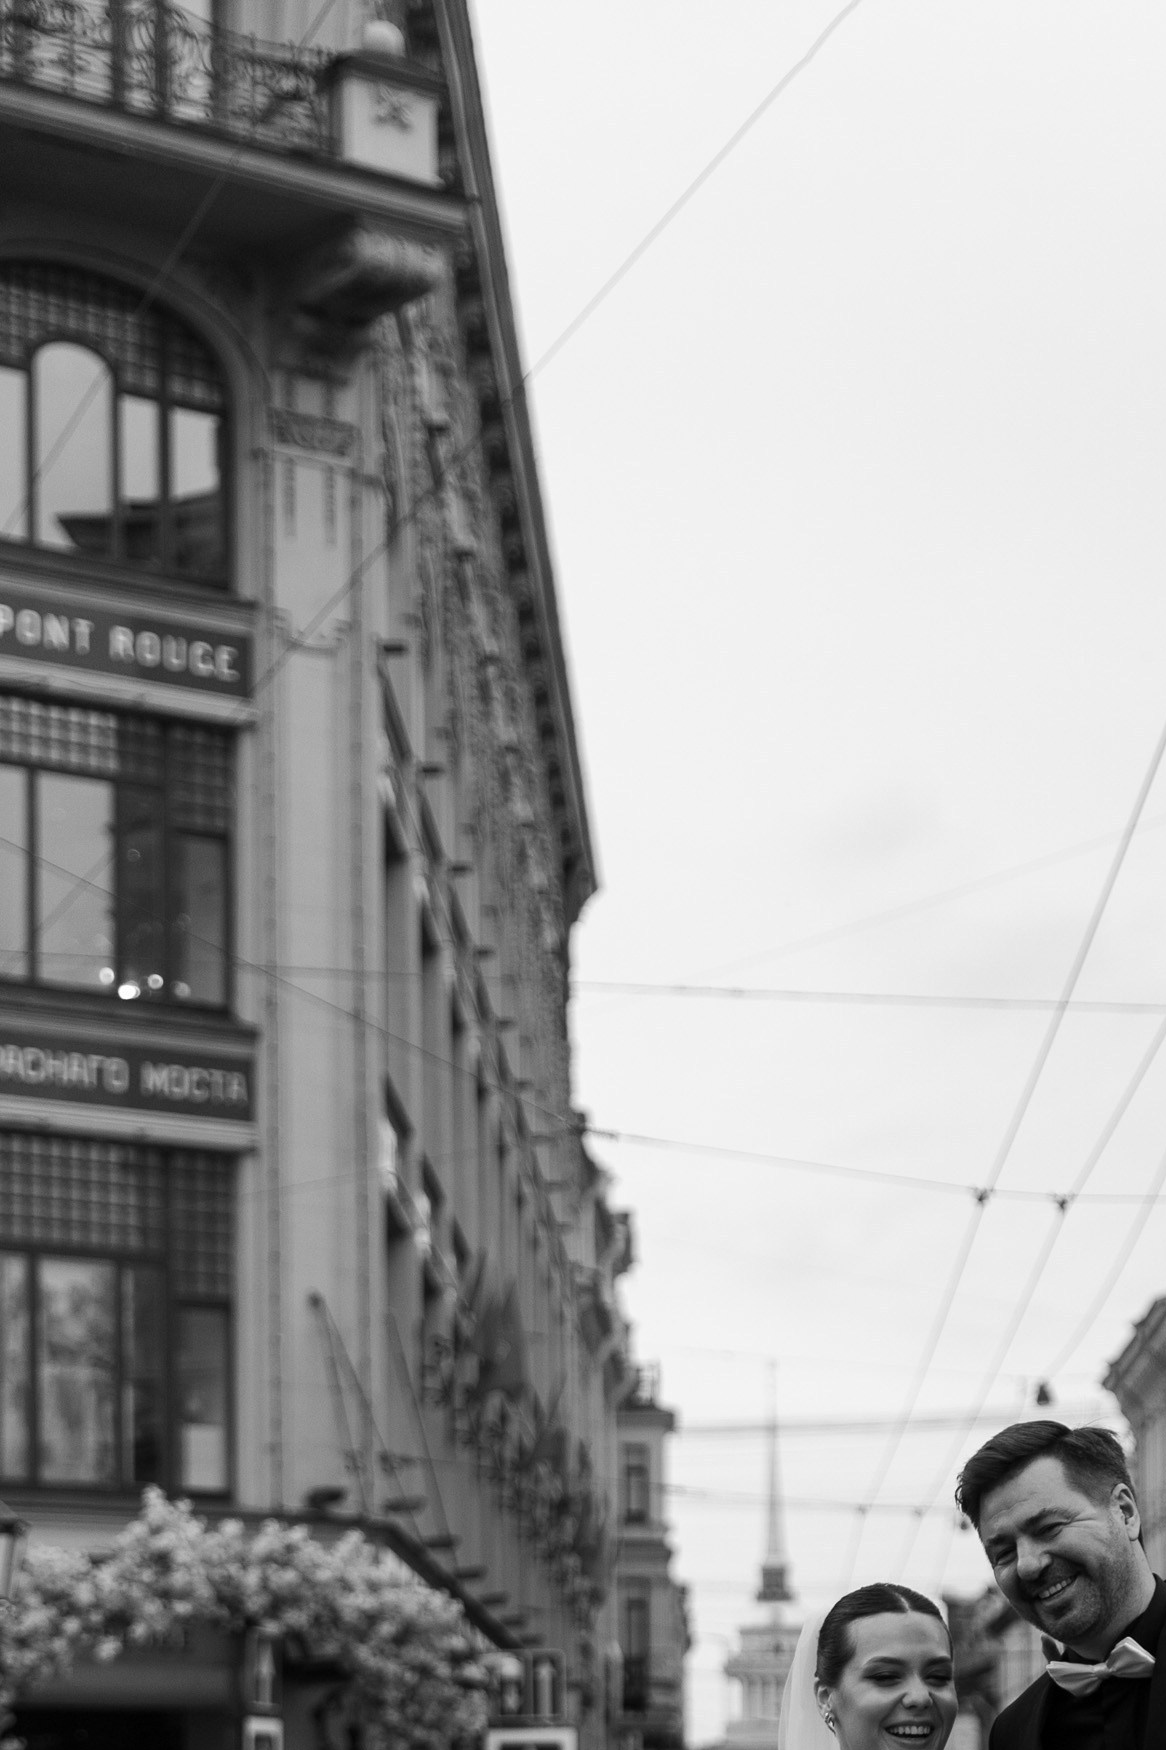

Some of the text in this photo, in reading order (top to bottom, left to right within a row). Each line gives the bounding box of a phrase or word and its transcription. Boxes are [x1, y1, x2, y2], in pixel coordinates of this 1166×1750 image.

[108, 625, 240, 682] ROUGE
[0, 1044, 248, 1102] АСНАГО МОСТА
